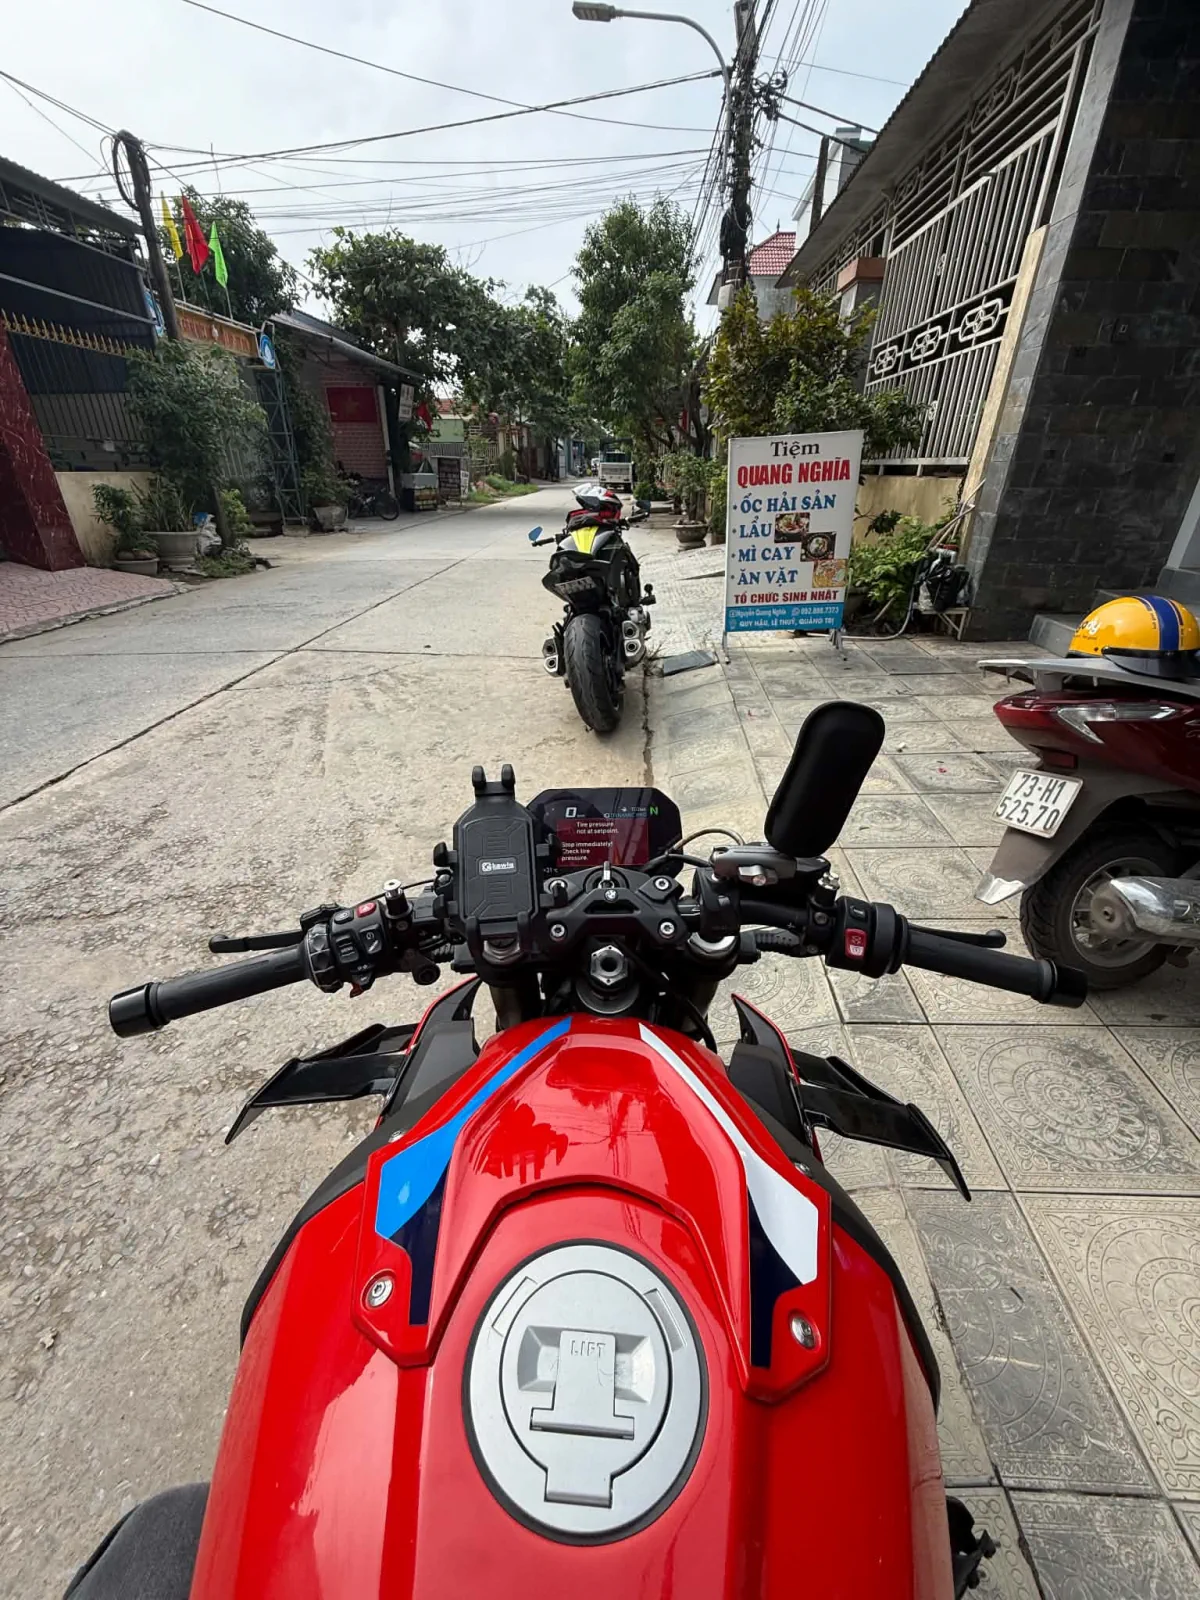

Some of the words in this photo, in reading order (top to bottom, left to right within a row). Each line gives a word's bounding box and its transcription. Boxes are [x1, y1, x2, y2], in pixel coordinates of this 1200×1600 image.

[770, 440, 820, 459] Tiệm
[737, 463, 793, 488] QUANG
[798, 457, 851, 483] NGHĨA
[740, 493, 763, 514] ỐC
[766, 491, 797, 512] HẢI
[801, 489, 837, 511] SẢN
[739, 515, 772, 539] LẨU
[738, 545, 757, 562] MÌ
[761, 546, 795, 561] CAY
[737, 569, 760, 585] ĂN
[765, 567, 798, 587] VẶT
[750, 591, 779, 604] CHỨC
[782, 591, 807, 603] SINH
[811, 589, 839, 602] NHẬT
[649, 806, 659, 815] N
[995, 796, 1061, 831] 525.70
[570, 1339, 606, 1358] LIFT
